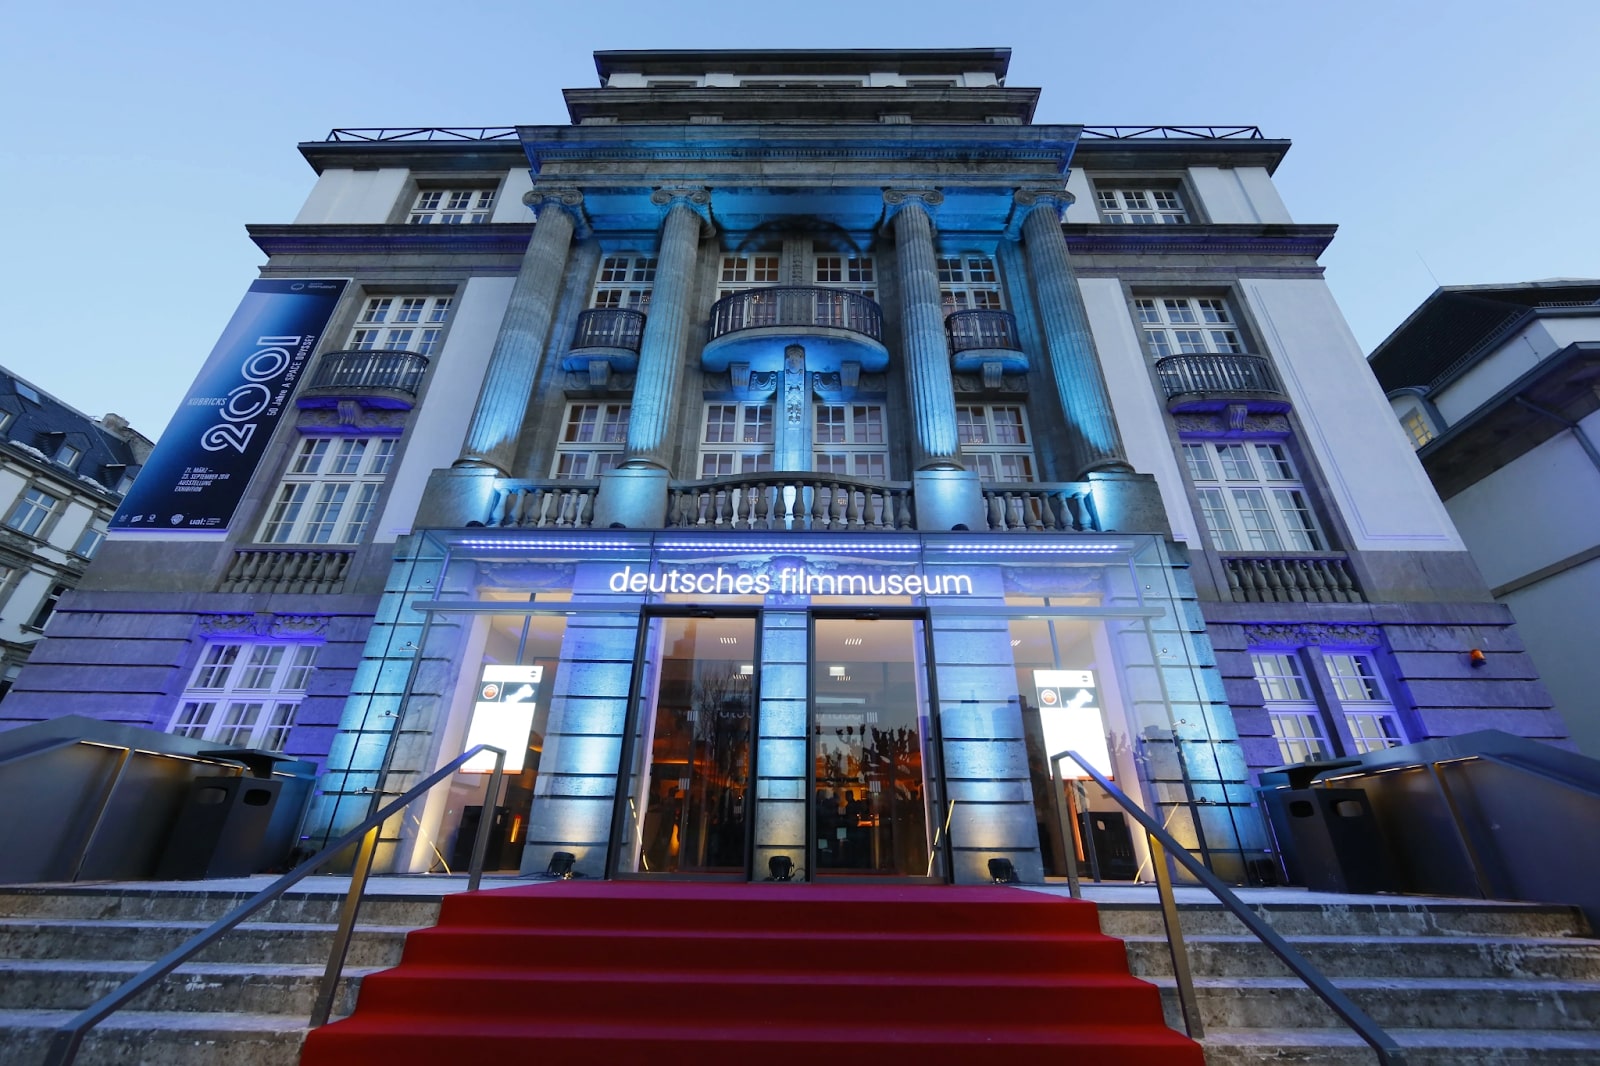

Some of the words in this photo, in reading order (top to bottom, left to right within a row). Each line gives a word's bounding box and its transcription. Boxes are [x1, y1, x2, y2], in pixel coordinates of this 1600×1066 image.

[285, 362, 302, 381] SPACE
[201, 336, 301, 453] 2001
[272, 390, 287, 406] Jahre
[267, 408, 279, 416] 50
[609, 566, 770, 594] deutsches
[779, 567, 973, 595] filmmuseum
